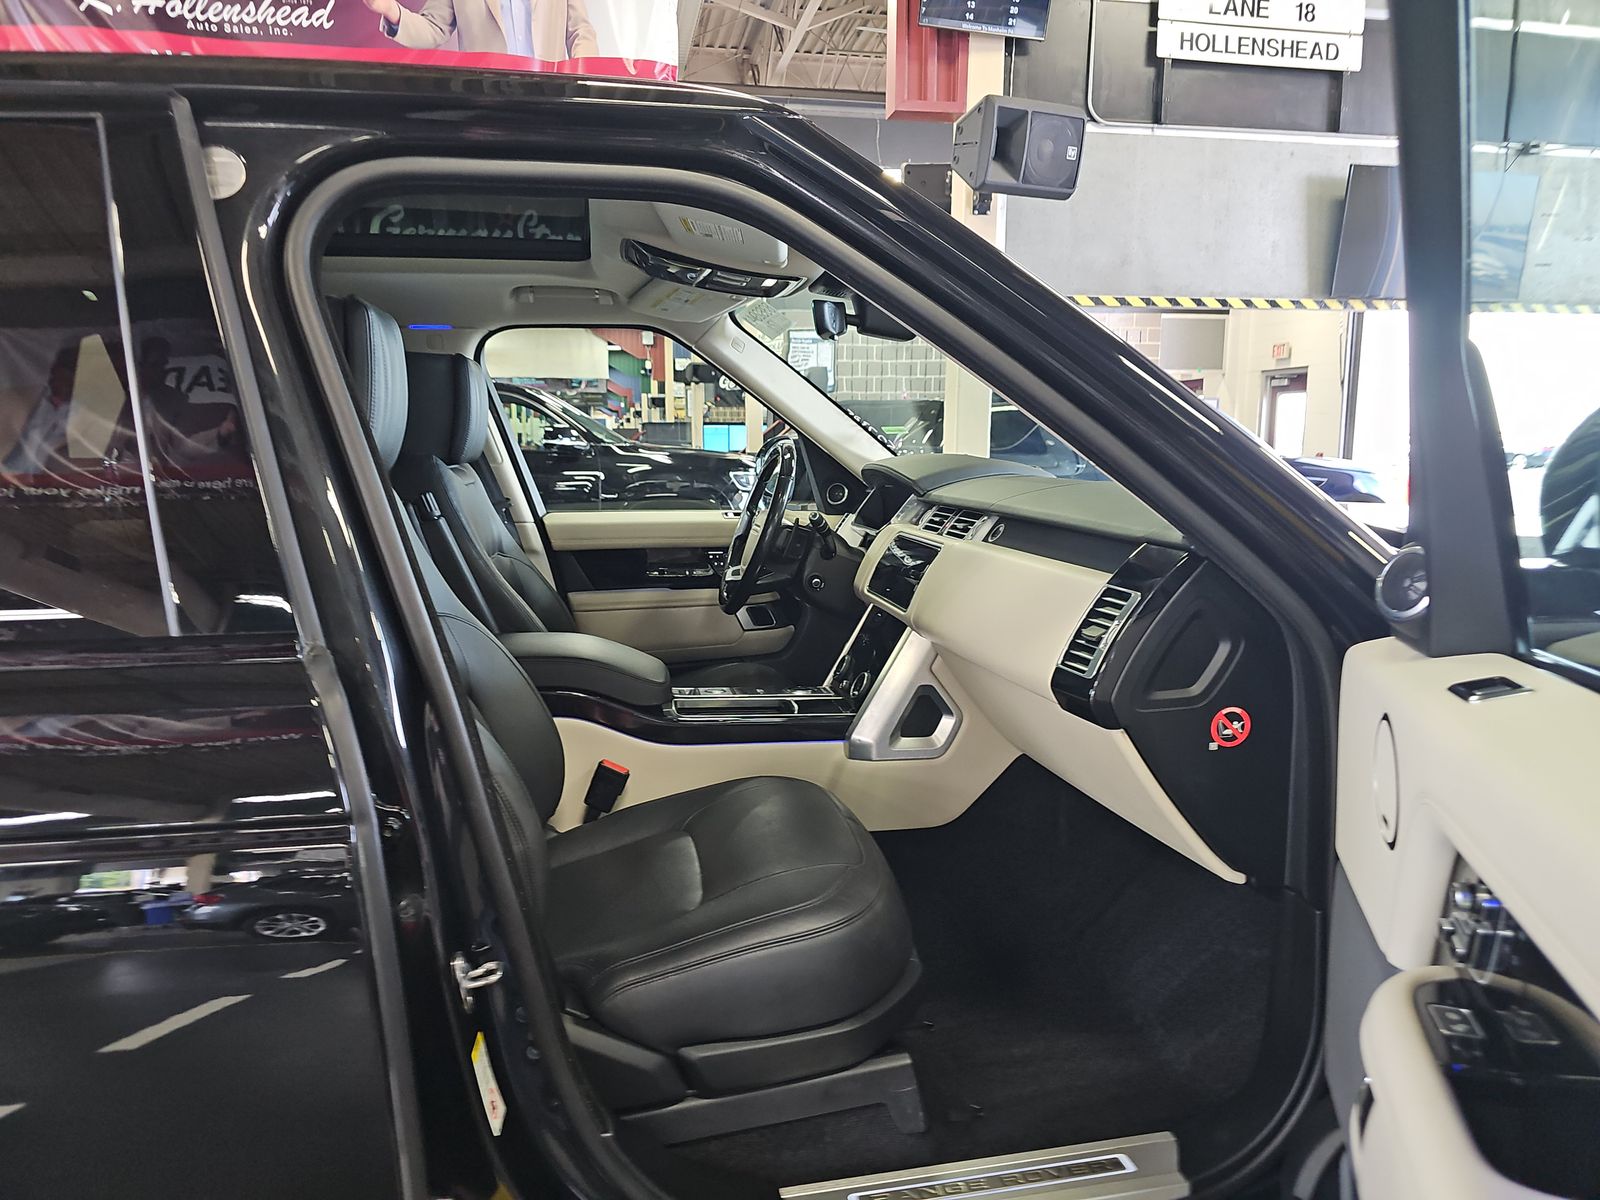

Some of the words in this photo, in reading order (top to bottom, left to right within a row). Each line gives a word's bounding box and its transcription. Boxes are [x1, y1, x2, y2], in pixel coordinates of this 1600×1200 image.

[966, 0, 976, 9] 13
[1009, 5, 1019, 15] 20
[1208, 0, 1270, 19] LANE
[1295, 2, 1316, 22] 18
[186, 19, 218, 33] Auto
[223, 22, 264, 36] Sales,
[268, 24, 294, 37] Inc.
[965, 11, 974, 21] 14
[1007, 17, 1017, 27] 21
[1179, 31, 1341, 62] HOLLENSHEAD
[1272, 343, 1286, 358] EXIT
[1000, 1160, 1115, 1186] ROVER
